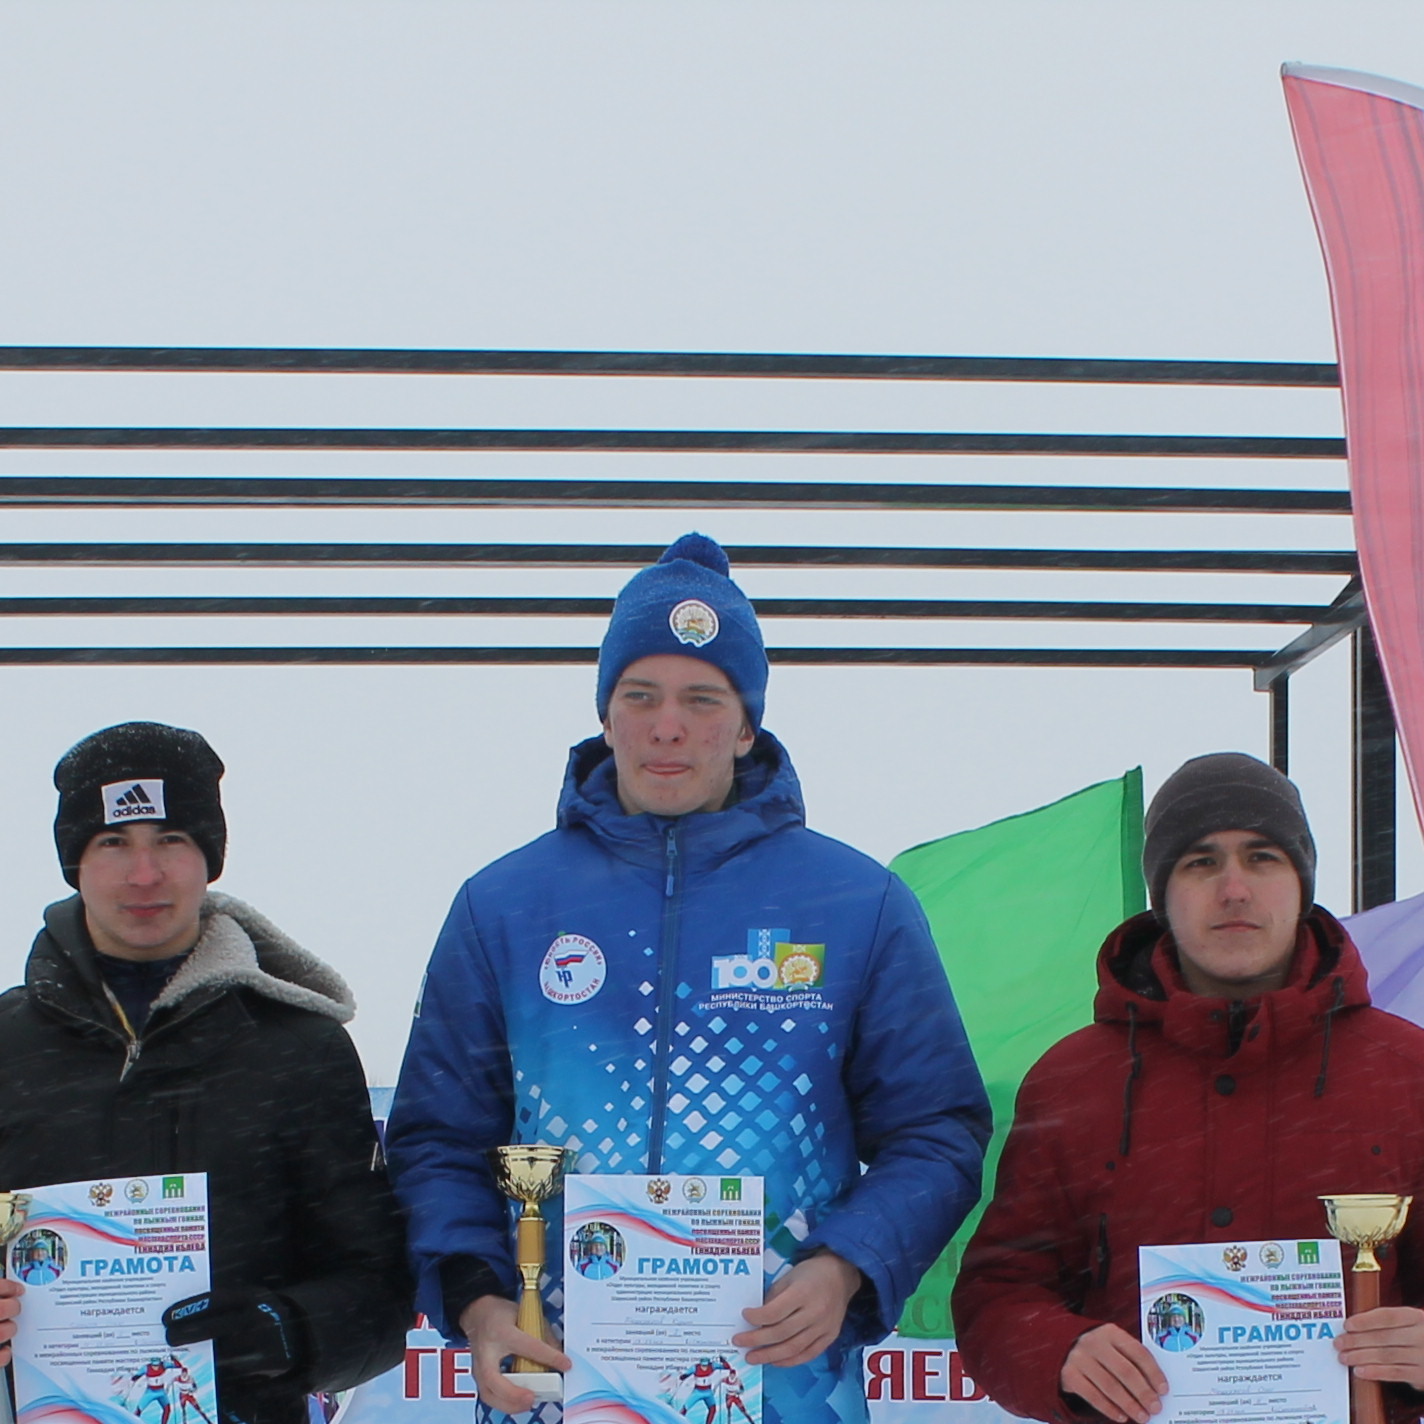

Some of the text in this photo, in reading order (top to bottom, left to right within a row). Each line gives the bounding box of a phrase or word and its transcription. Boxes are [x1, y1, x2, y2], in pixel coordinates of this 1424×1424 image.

[112, 804, 156, 818] adidas
[714, 957, 778, 989] 100
[711, 992, 822, 1003] МИНИСТЕРСТВО СПОРТА
[699, 1000, 833, 1011] РЕСПУБЛИКИ БАШКОРТОСТАН
[79, 1255, 195, 1277] ГРАМОТА
[638, 1257, 751, 1276] ГРАМОТА
[80, 1306, 144, 1317] награждается
[635, 1306, 698, 1314] награждается
[1218, 1323, 1334, 1343] ГРАМОТА
[404, 1348, 995, 1401] ГЕ ЯЕВ
[1217, 1373, 1283, 1383] награждается
